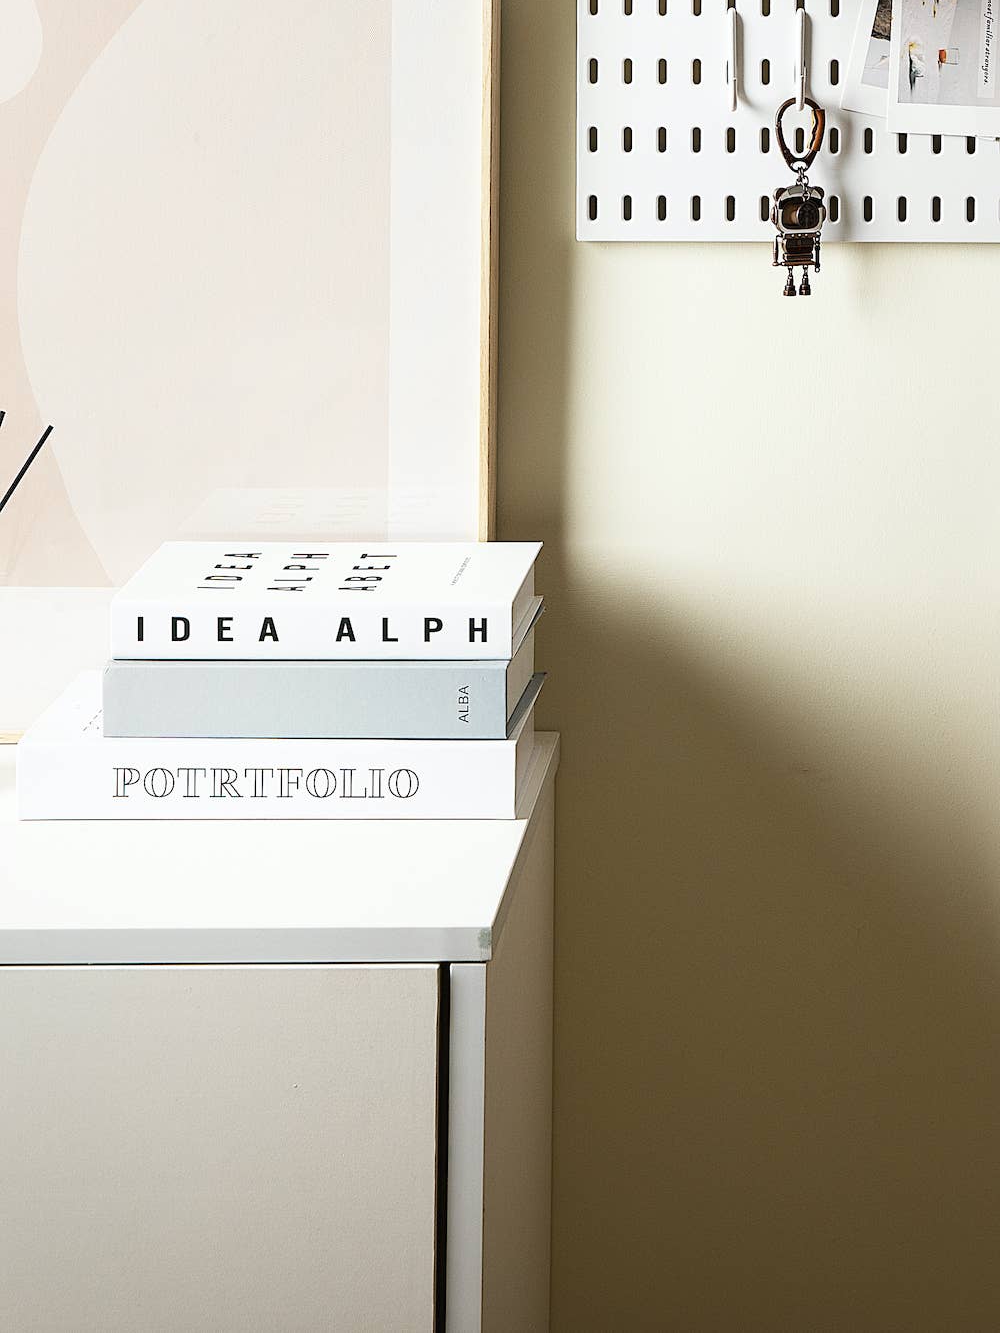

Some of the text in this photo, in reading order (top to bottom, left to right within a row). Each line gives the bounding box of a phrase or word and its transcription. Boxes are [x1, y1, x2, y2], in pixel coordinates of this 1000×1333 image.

[197, 552, 263, 590] IDEA
[267, 553, 330, 592] ALPH
[338, 553, 397, 592] ABET
[137, 616, 489, 643] IDEA ALPH
[457, 684, 470, 723] ALBA
[112, 767, 420, 799] POTRTFOLIO
